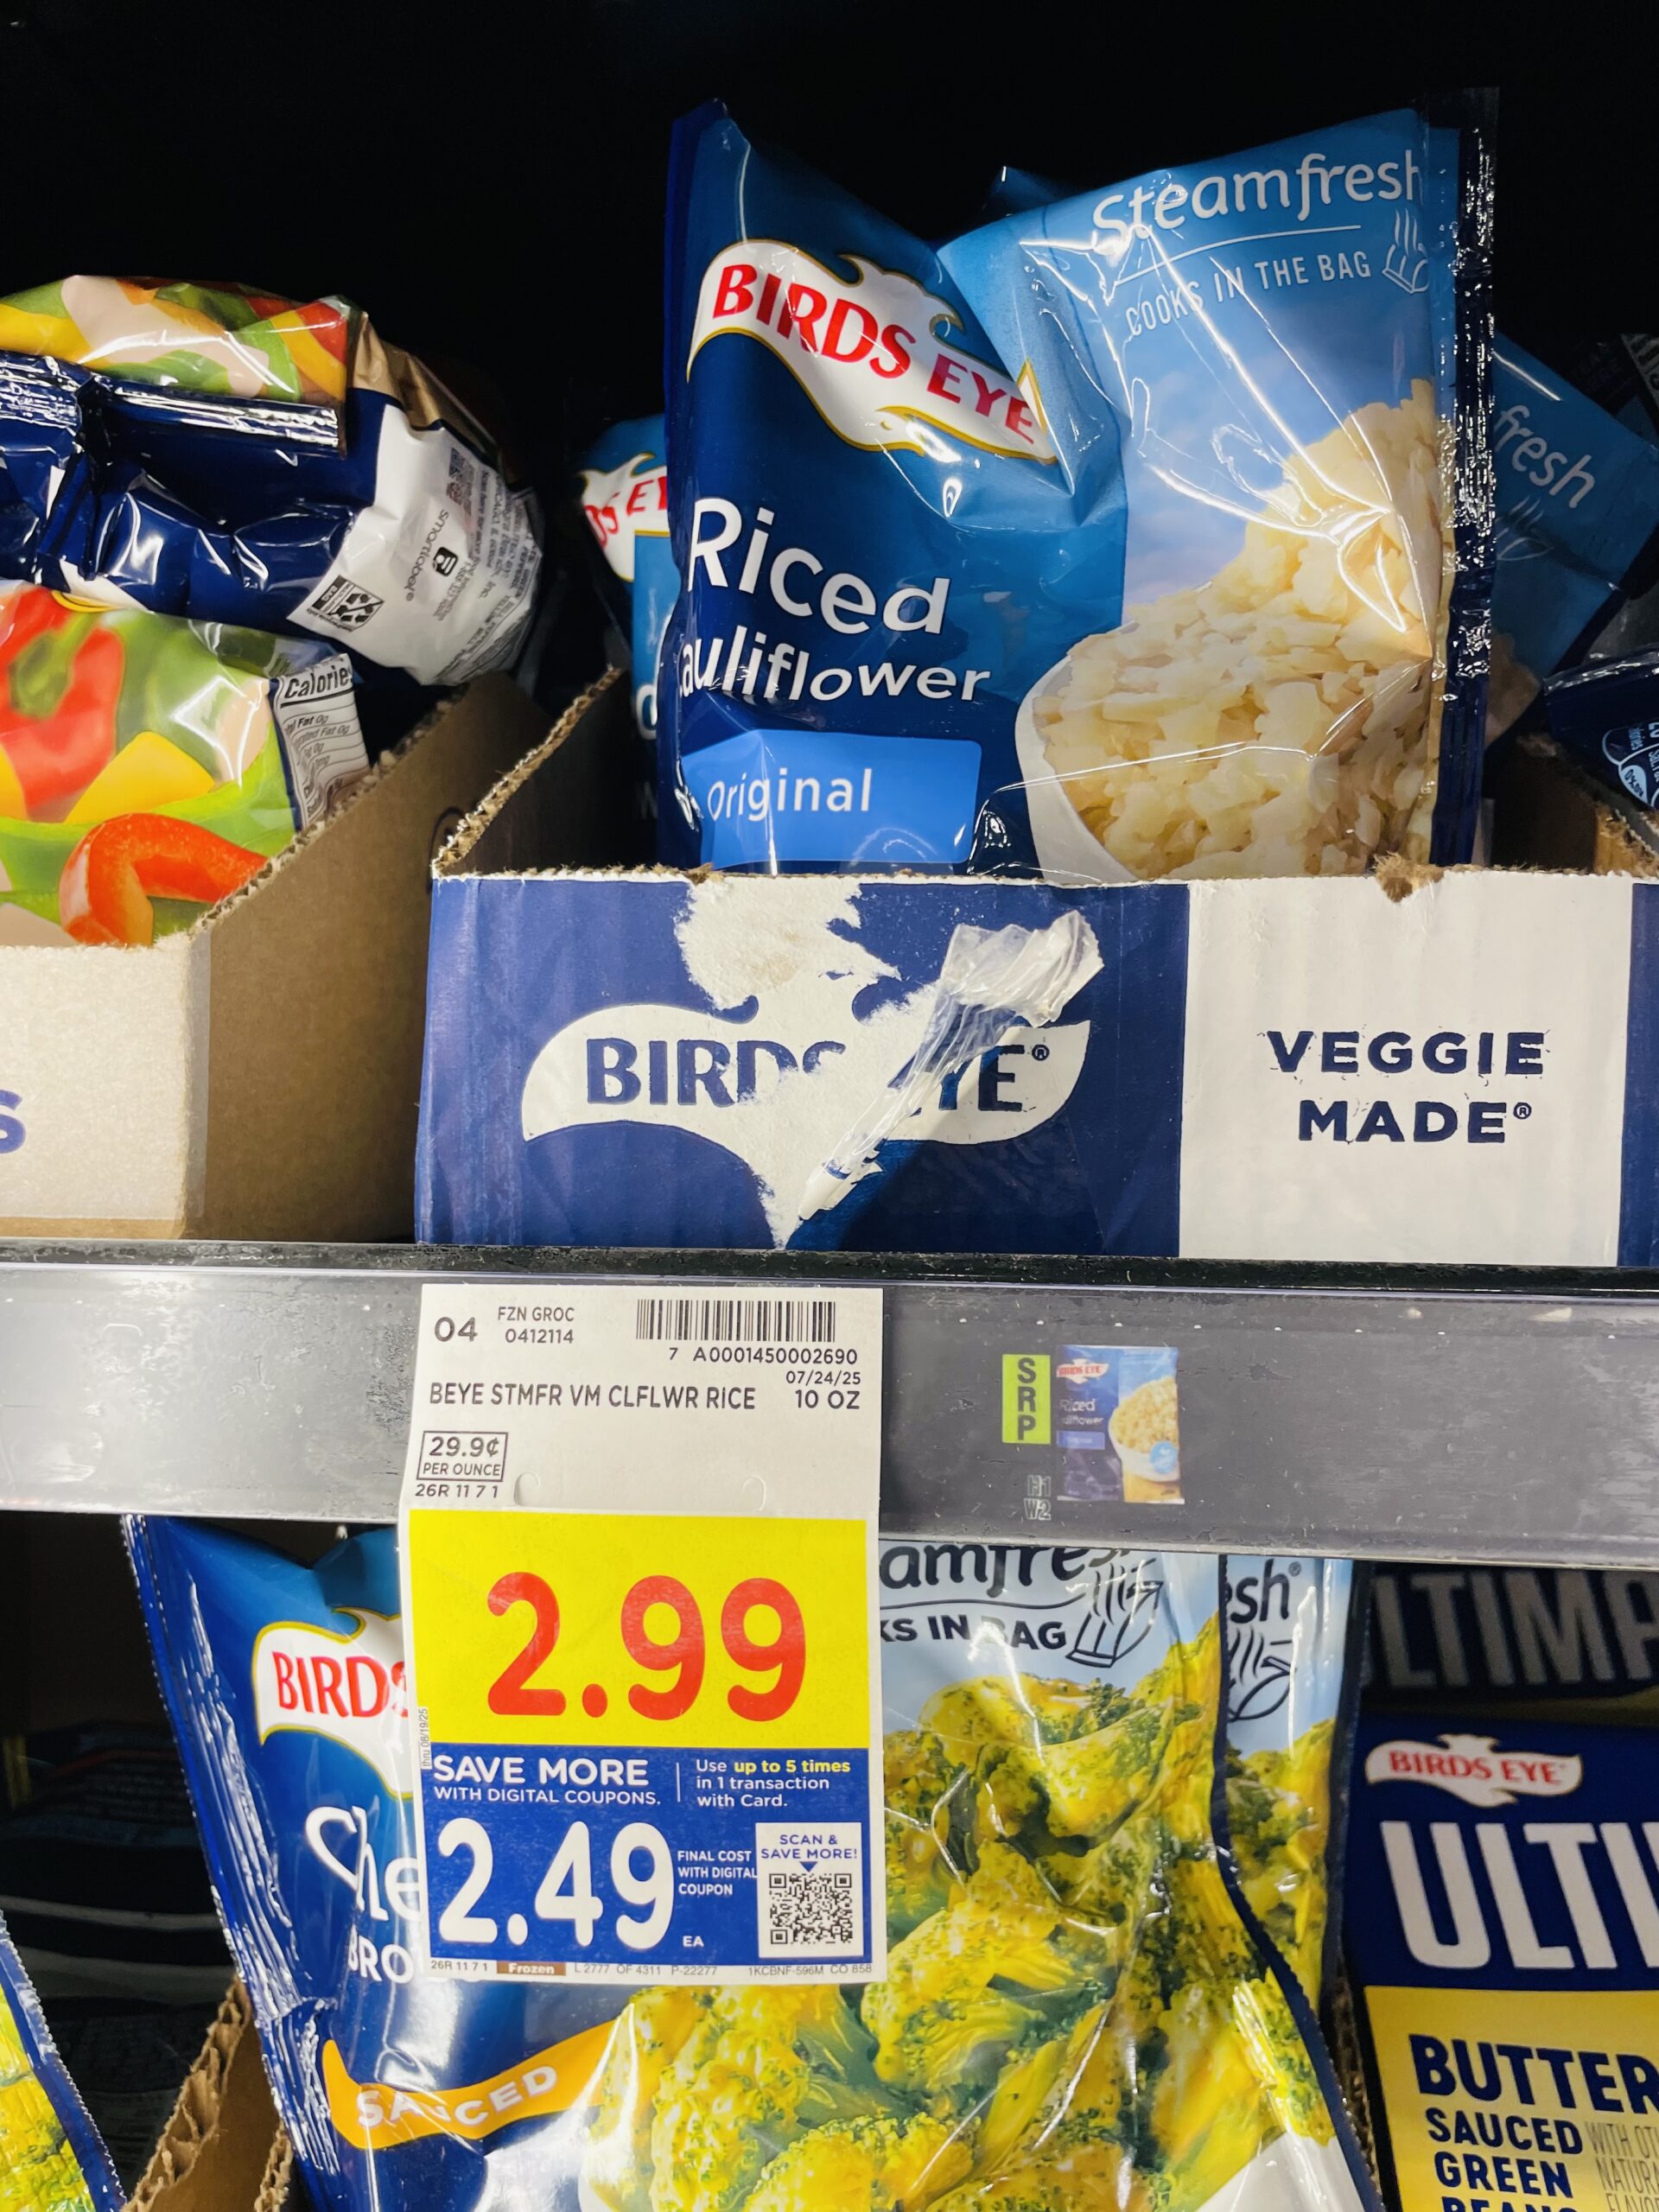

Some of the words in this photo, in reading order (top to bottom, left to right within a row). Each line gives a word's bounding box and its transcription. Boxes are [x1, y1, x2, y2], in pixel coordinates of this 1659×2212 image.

[1125, 281, 1204, 338] COOKS
[1213, 265, 1244, 302] IN
[1261, 256, 1312, 291] THE
[1320, 251, 1372, 283] BAG
[712, 263, 917, 379] BIRDS
[926, 353, 1035, 445] EYE
[687, 498, 951, 635] Riced
[679, 626, 992, 703] auliflower
[284, 664, 353, 699] Calorie
[1267, 1030, 1545, 1075] VEGGIE
[498, 1306, 527, 1321] FZN
[531, 1306, 575, 1322] GROC
[434, 1316, 478, 1342] 04
[505, 1328, 575, 1344] 0412114
[669, 1347, 678, 1361] 7
[692, 1346, 858, 1365] A0001450002690
[785, 1369, 861, 1386] 07/24/25
[429, 1382, 485, 1405] BEYE
[491, 1382, 563, 1406] STMFR
[569, 1384, 601, 1407] VM
[608, 1384, 699, 1409] CLFLWR
[706, 1386, 756, 1410] RICE
[795, 1389, 819, 1409] 10
[827, 1389, 861, 1410] OZ
[429, 1435, 499, 1458] 29.9¢
[423, 1462, 448, 1476] PER
[452, 1462, 501, 1477] OUNCE
[416, 1484, 449, 1498] 26R
[927, 1614, 971, 1641] IN
[486, 1571, 806, 1722] 2.99
[419, 1707, 430, 1748] 08/19/25
[433, 1754, 526, 1783] SAVE
[537, 1757, 650, 1786] MORE
[696, 1758, 728, 1773] Use
[734, 1761, 757, 1776] up
[761, 1760, 781, 1773] to
[785, 1759, 798, 1773] 5
[801, 1759, 851, 1773] times
[1389, 1750, 1493, 1780] BIRDS
[1501, 1760, 1562, 1785] EYE
[696, 1776, 712, 1789] in
[717, 1777, 724, 1789] 1
[729, 1777, 830, 1790] transaction
[434, 1785, 482, 1801] WITH
[486, 1787, 560, 1804] DIGITAL
[564, 1789, 662, 1806] COUPONS.
[696, 1793, 735, 1807] with
[740, 1794, 789, 1808] Card.
[779, 1834, 823, 1846] SCAN
[828, 1834, 838, 1846] &
[677, 1850, 712, 1862] FINAL
[717, 1850, 752, 1862] COST
[760, 1847, 802, 1859] SAVE
[805, 1848, 858, 1859] MORE!
[436, 1816, 675, 1950] 2.49
[677, 1866, 709, 1878] WITH
[712, 1866, 758, 1879] DIGITAL
[677, 1883, 733, 1896] COUPON
[682, 1935, 705, 1948] EA
[431, 1960, 453, 1971] 26R
[508, 1962, 556, 1974] Frozen
[616, 1963, 633, 1974] OF
[830, 1964, 849, 1974] CO
[851, 1964, 873, 1974] 858
[1408, 2033, 1659, 2114] BUTTER
[1426, 2107, 1584, 2155] SAUCED
[1585, 2120, 1633, 2158] WITH
[1433, 2151, 1573, 2199] GREEN
